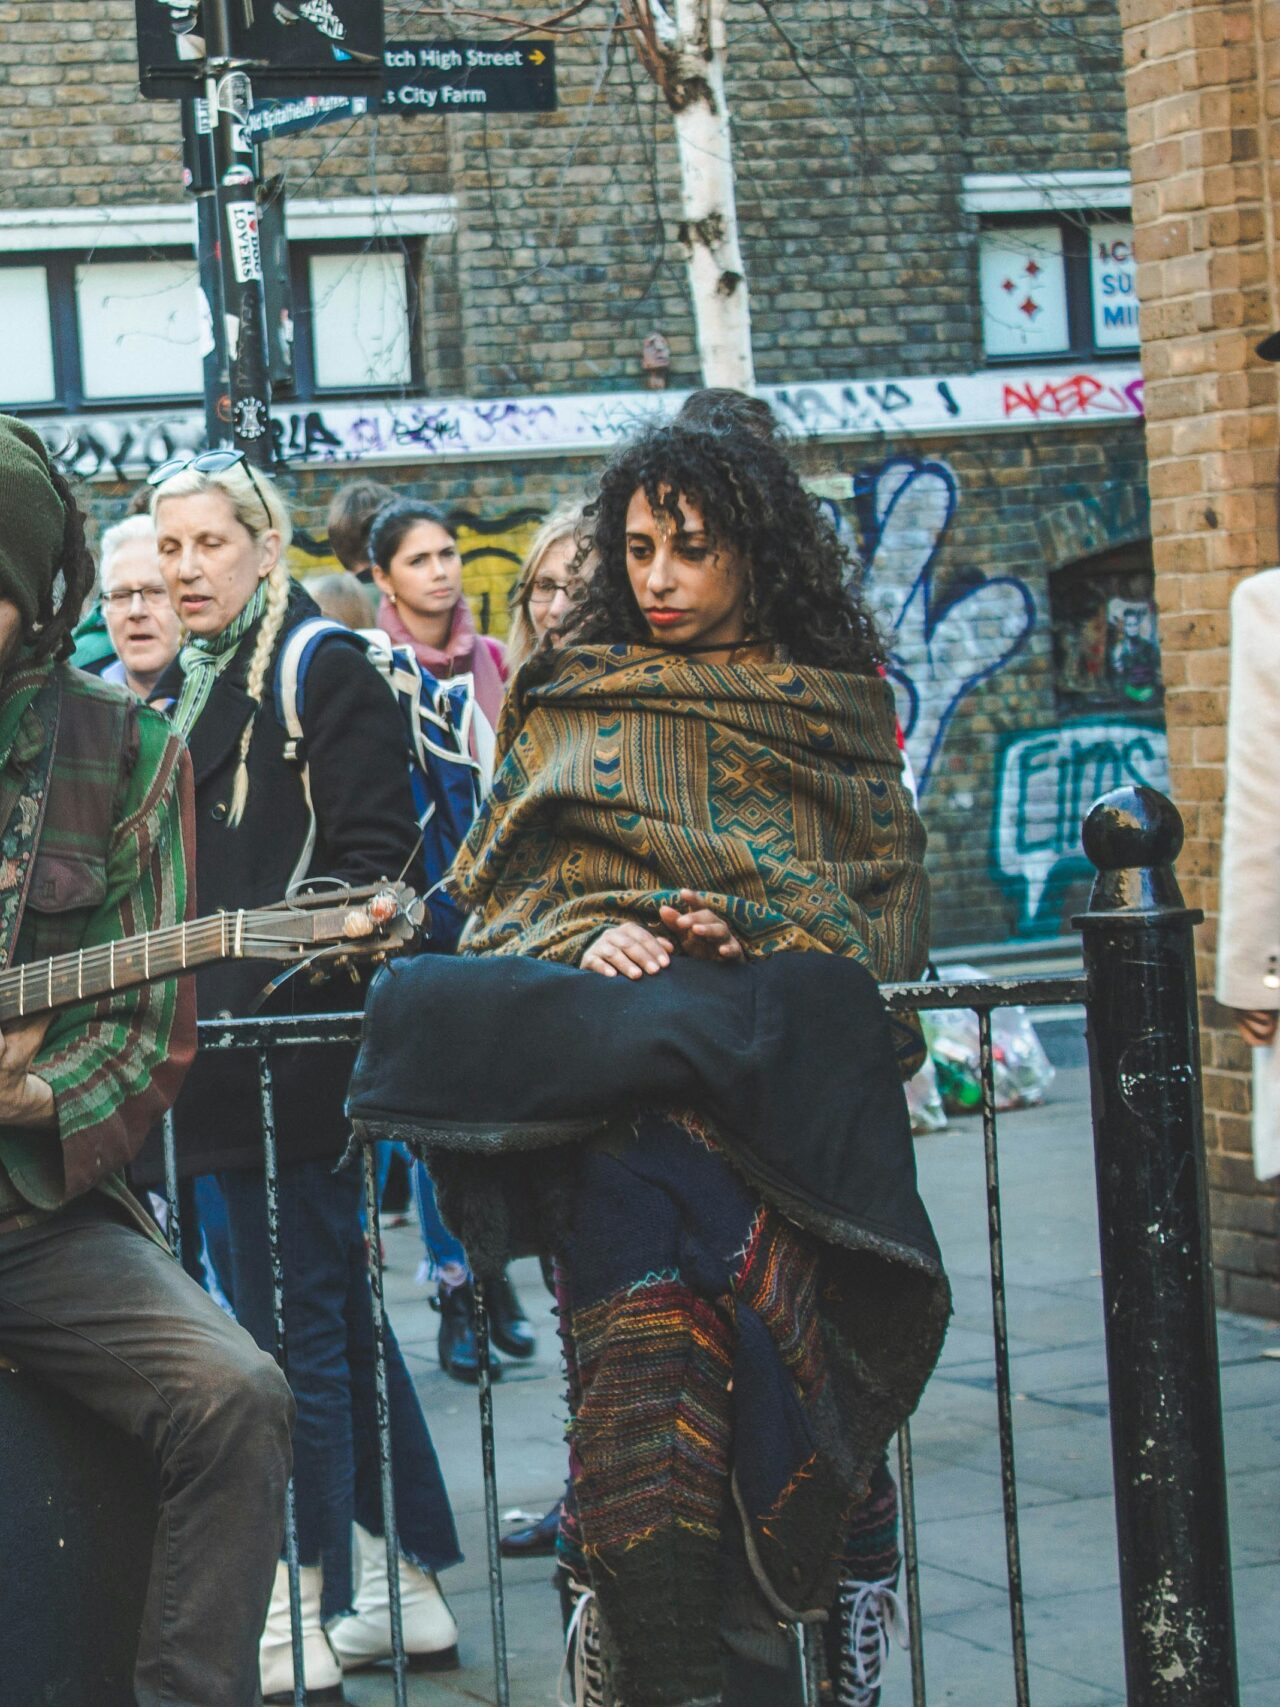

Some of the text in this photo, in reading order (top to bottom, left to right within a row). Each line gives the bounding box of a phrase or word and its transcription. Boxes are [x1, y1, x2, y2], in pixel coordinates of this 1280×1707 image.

[384, 49, 524, 70] tch High Street
[381, 85, 487, 107] s City Farm
[234, 208, 253, 278] LOVERS
